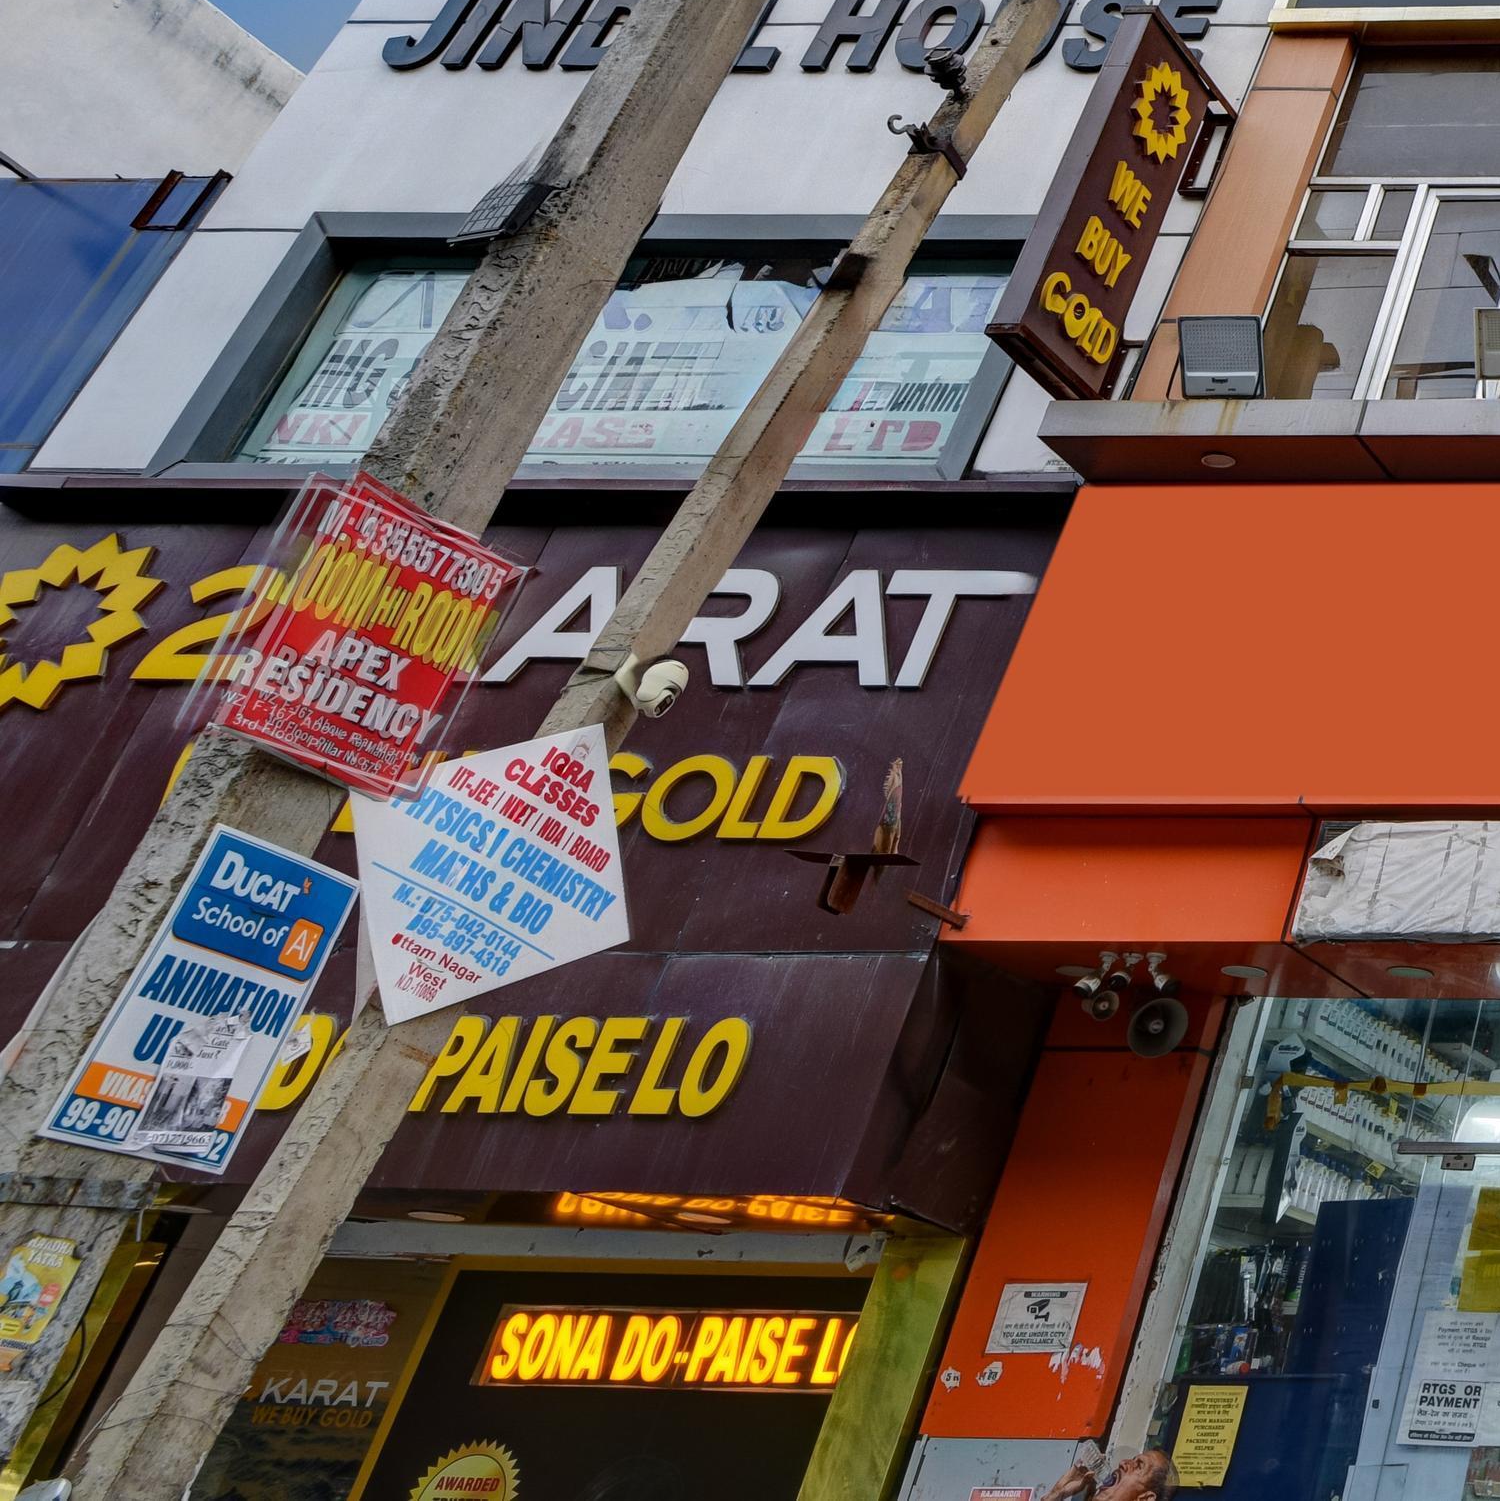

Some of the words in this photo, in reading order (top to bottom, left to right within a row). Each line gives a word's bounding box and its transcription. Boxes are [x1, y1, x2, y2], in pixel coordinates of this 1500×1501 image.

[1107, 160, 1153, 231] WE
[1075, 215, 1133, 290] BUY
[1039, 271, 1118, 366] GOLD
[482, 566, 1038, 688] ARAT
[303, 630, 412, 692] APEX
[229, 646, 443, 745] RESIDENCY
[504, 757, 600, 828] CLASSES
[540, 745, 596, 794] IQRA
[448, 765, 501, 807] IIT-JEE
[537, 818, 565, 847] NDA
[567, 835, 612, 874] BOARD
[210, 850, 301, 913] DUCAT
[490, 881, 515, 915] &
[508, 891, 553, 935] BIO
[500, 838, 617, 922] CHEMISTRY
[191, 896, 261, 940] School
[262, 925, 289, 948] of
[391, 932, 437, 963] ttam
[438, 952, 483, 985] Nagar
[407, 961, 448, 991] West
[138, 954, 298, 1039] ANIMATION
[491, 1312, 613, 1380] SONA
[258, 1376, 390, 1408] KARAT
[281, 1405, 318, 1427] BUY
[320, 1407, 374, 1429] GOLD
[1418, 1395, 1481, 1409] PAYMENT
[1421, 1382, 1457, 1395] RTGS
[1464, 1385, 1483, 1397] OR
[434, 1475, 501, 1493] AWARDED
